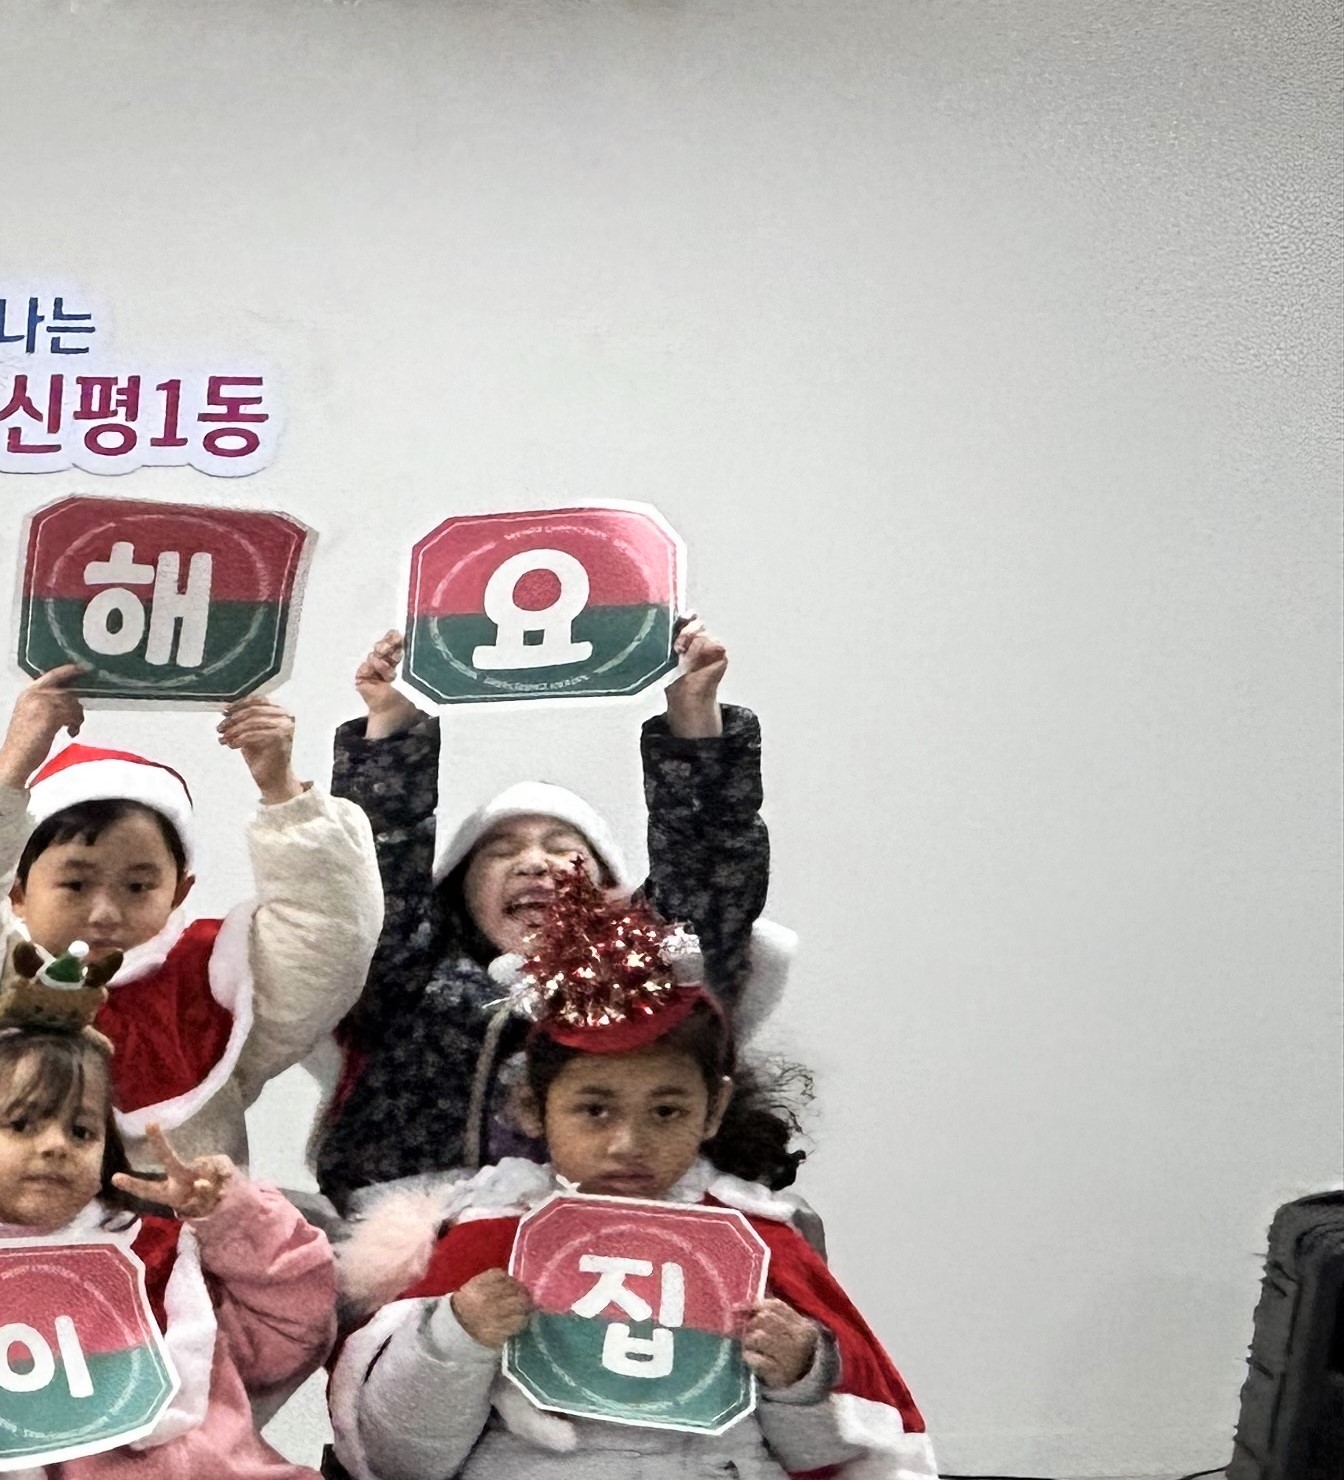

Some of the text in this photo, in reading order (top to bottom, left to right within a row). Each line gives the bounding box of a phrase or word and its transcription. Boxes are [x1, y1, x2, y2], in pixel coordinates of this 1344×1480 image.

[82, 541, 213, 668] 해
[471, 548, 593, 670] 요
[570, 1254, 686, 1379] 집
